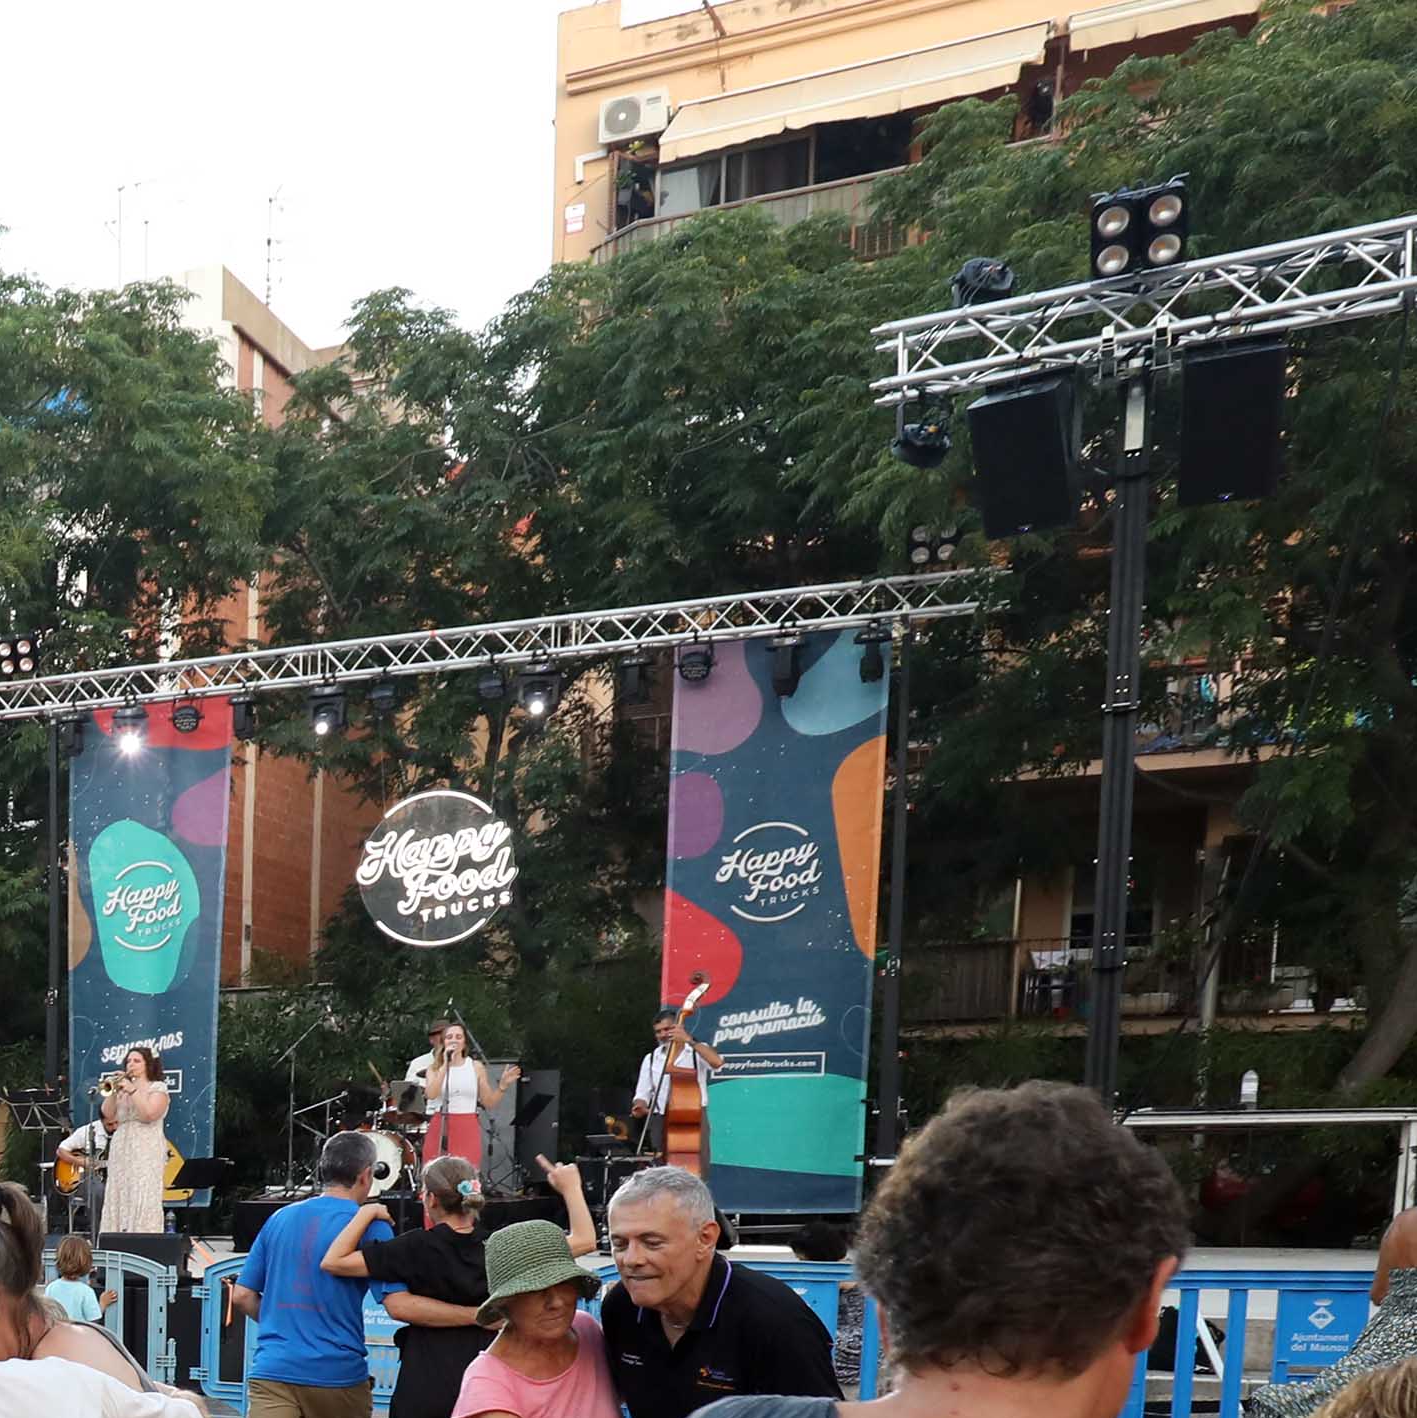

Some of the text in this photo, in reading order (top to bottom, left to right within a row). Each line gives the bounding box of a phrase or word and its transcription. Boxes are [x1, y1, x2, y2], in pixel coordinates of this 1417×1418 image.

[356, 821, 511, 885] Happy
[715, 842, 819, 882] Happy
[102, 880, 180, 916] Happy
[397, 847, 519, 915] Food
[744, 858, 822, 901] Food
[759, 886, 820, 907] TRUCKS
[125, 893, 182, 932] Food
[419, 891, 511, 923] TRUCKS
[137, 918, 181, 937] TRUCKS
[712, 1008, 826, 1047] programació
[719, 997, 817, 1027] consulta la
[721, 1059, 816, 1071] appyfoodtrucks.com
